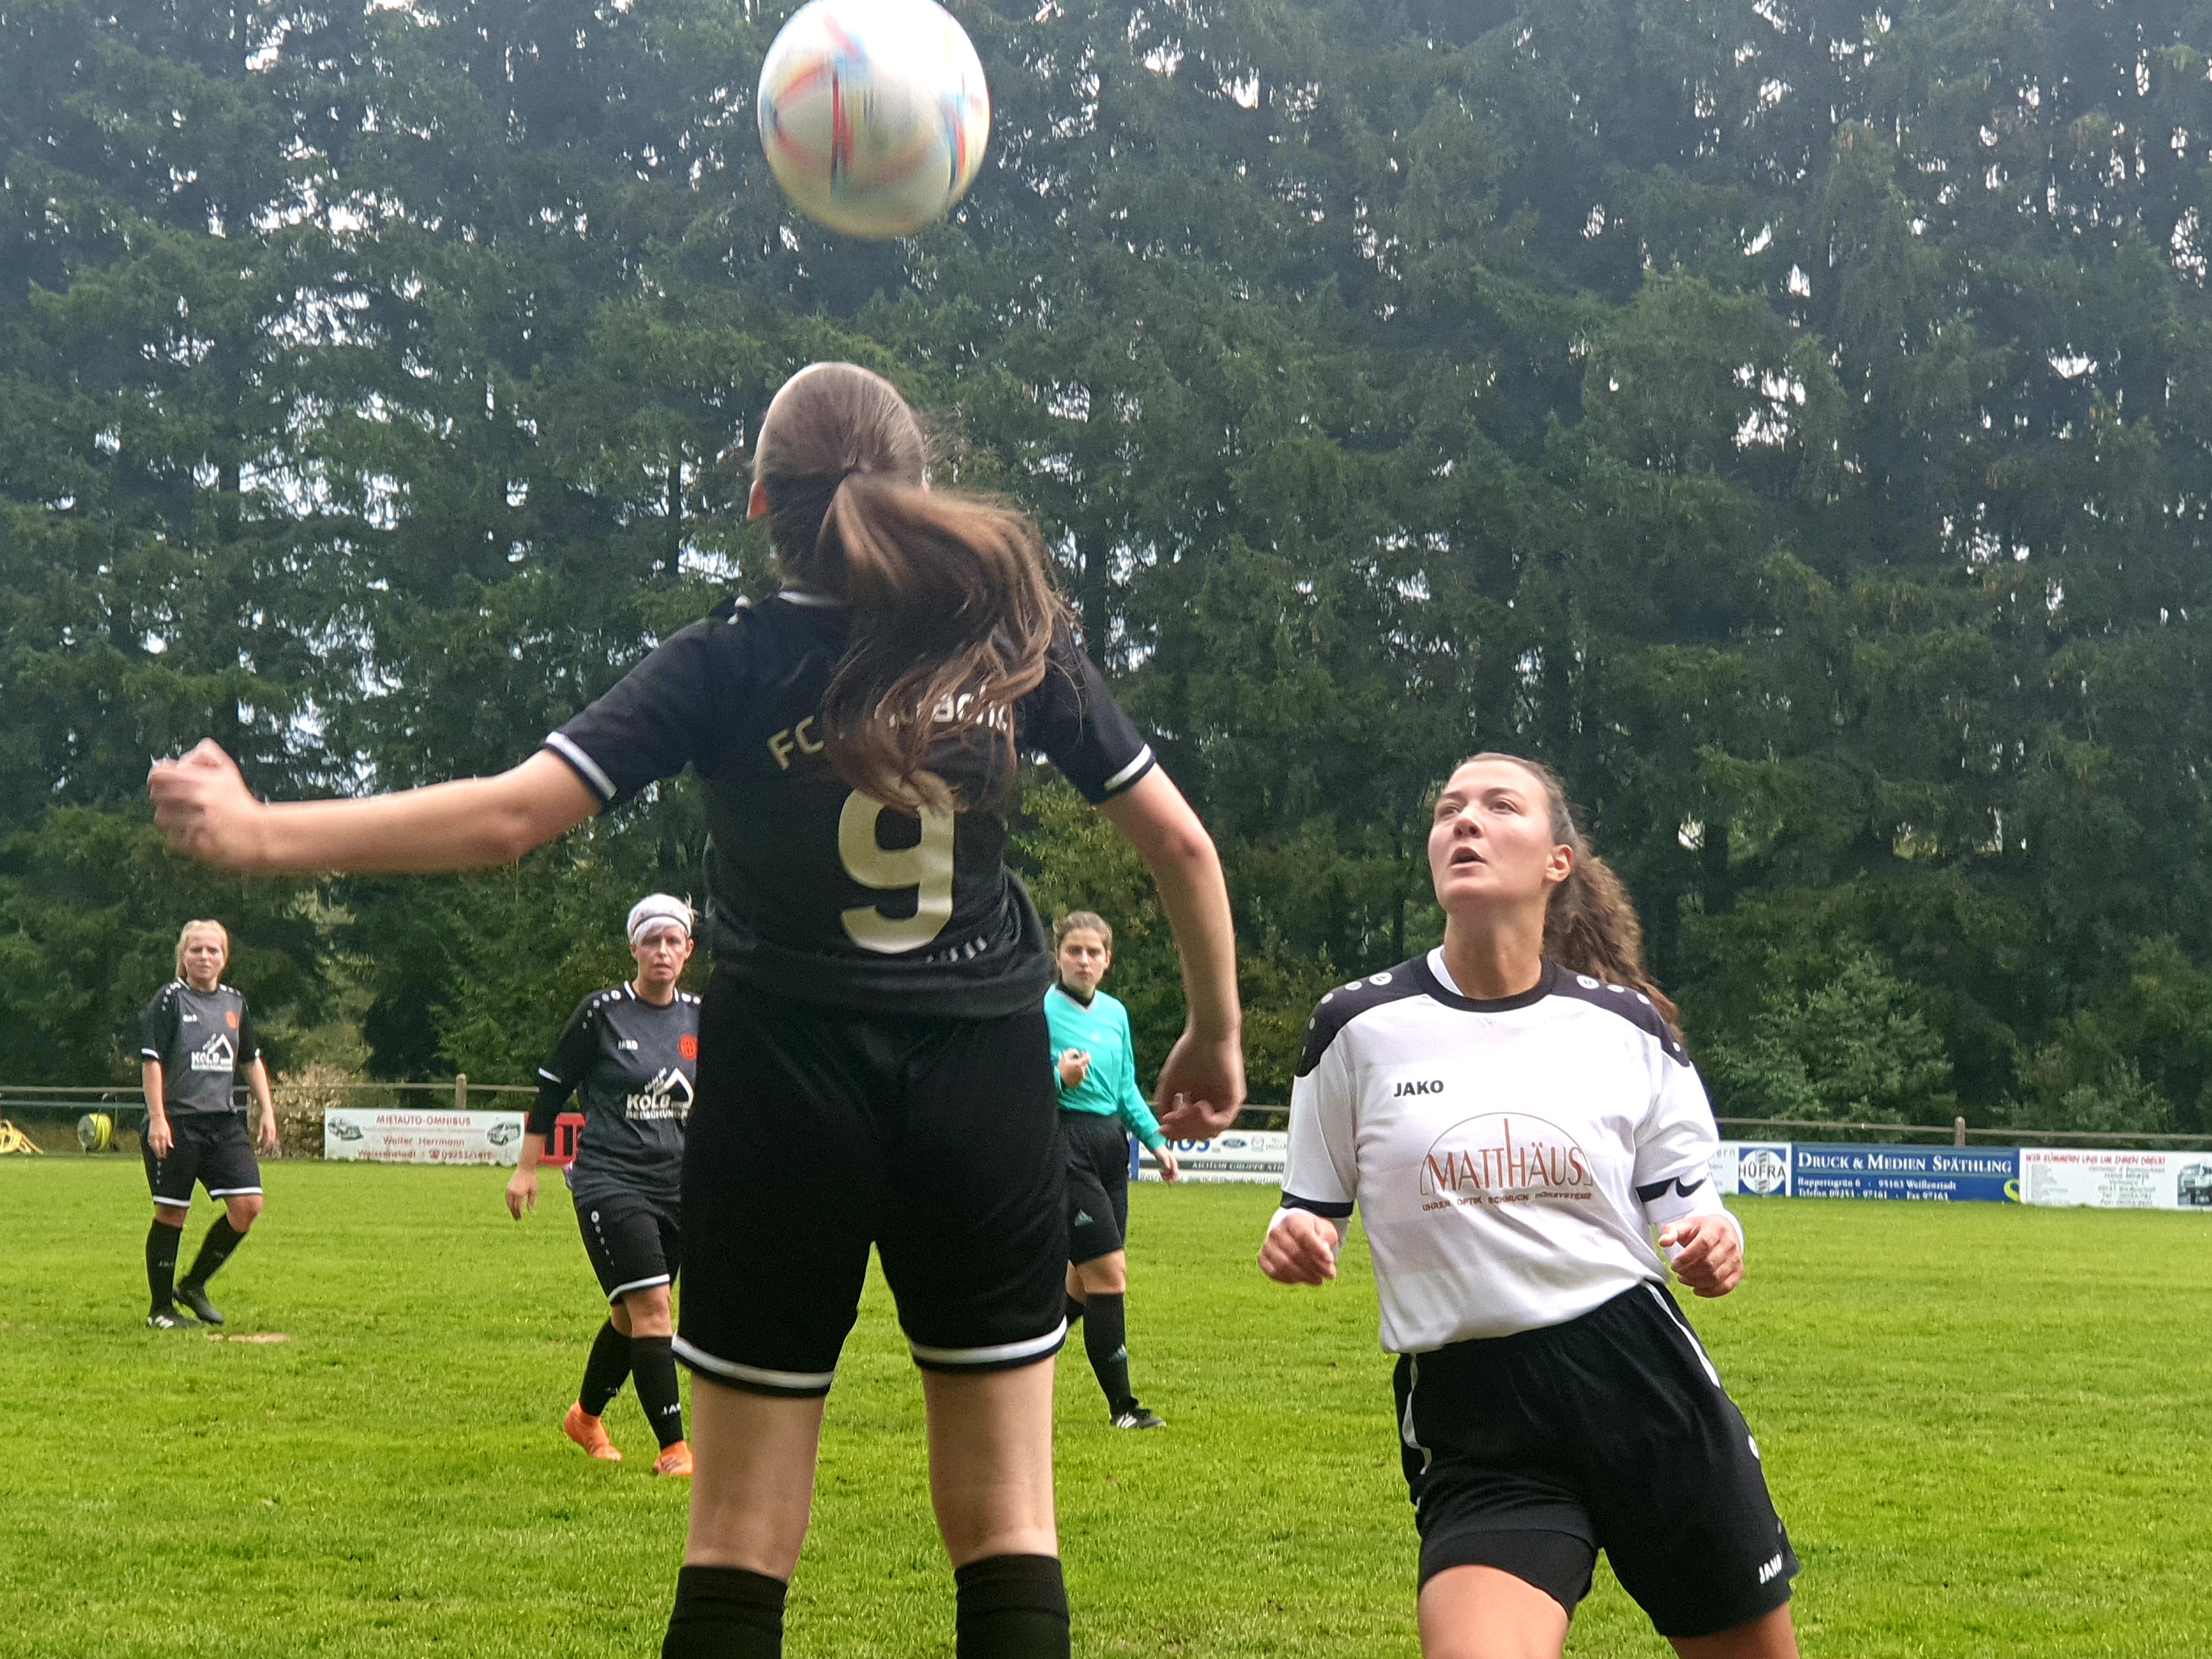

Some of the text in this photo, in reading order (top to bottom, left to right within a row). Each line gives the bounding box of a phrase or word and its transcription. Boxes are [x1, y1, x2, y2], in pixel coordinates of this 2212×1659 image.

[767, 715, 824, 770] FC
[838, 788, 954, 954] 9
[1394, 1080, 1444, 1097] JAKO
[1427, 1118, 1583, 1193] MATTHÄUS
[1798, 1153, 2012, 1173] DRUCK & MEDIEN SPÄTHLING
[1422, 1200, 1451, 1212] UHREN
